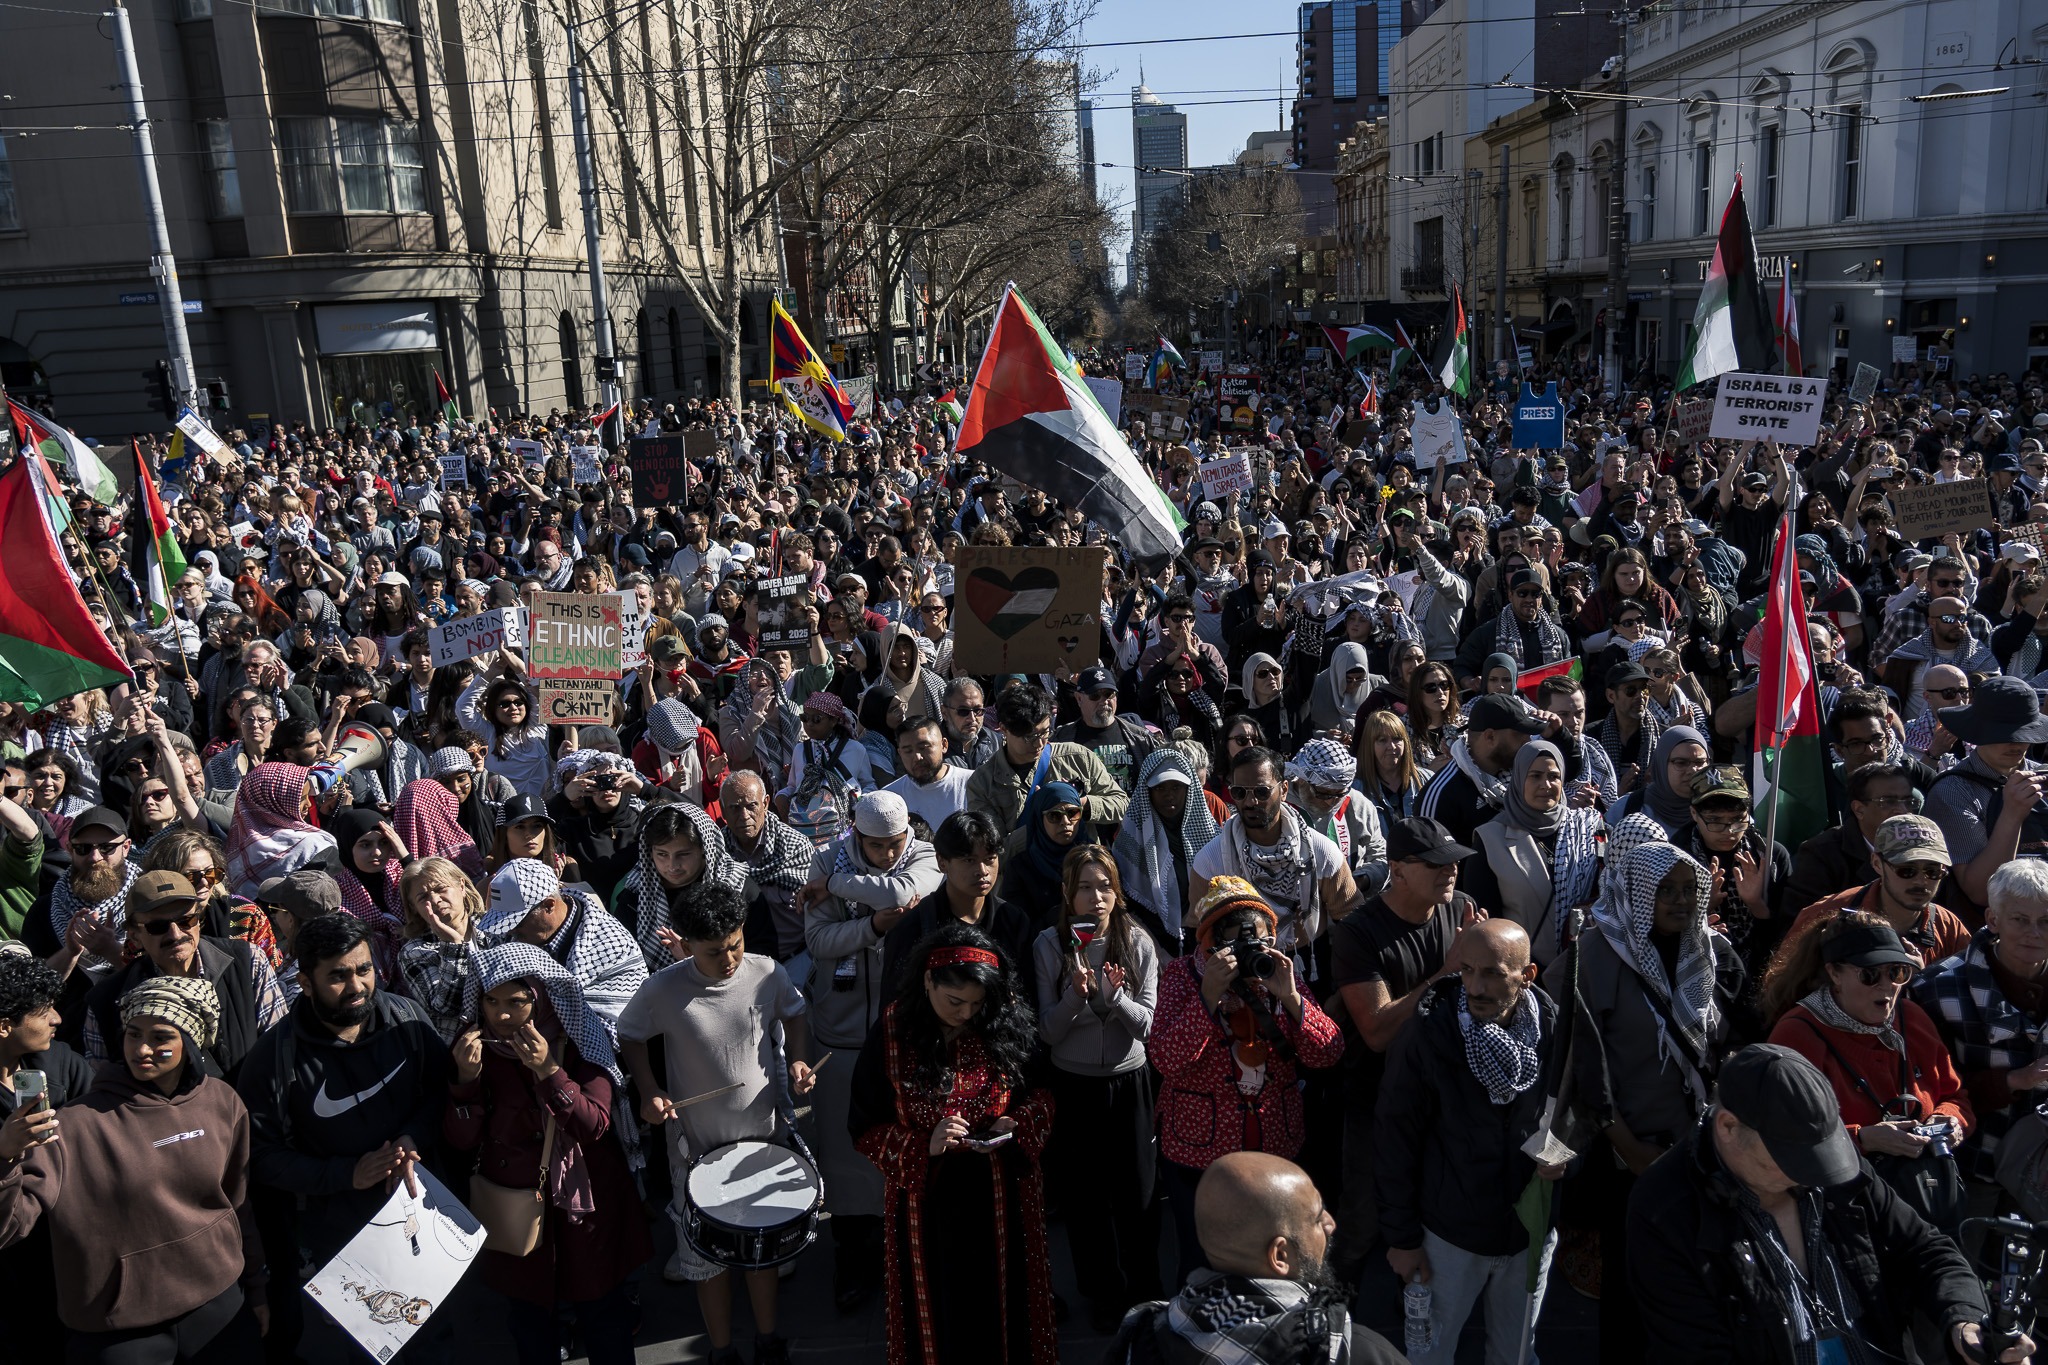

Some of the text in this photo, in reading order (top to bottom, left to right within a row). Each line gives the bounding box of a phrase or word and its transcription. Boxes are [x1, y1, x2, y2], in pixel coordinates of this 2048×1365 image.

[1936, 43, 1963, 56] 1863
[338, 320, 422, 332] HOTEL WINDSOR
[1221, 378, 1248, 388] Rotten
[1725, 379, 1818, 396] ISRAEL IS A
[1220, 386, 1257, 396] Politicians
[1686, 401, 1708, 415] STOP
[1725, 396, 1814, 413] TERRORIST
[1520, 408, 1555, 418] PRESS
[1680, 411, 1713, 428] ARMING
[1738, 415, 1789, 429] STATE
[1685, 423, 1709, 438] ISRAE
[644, 444, 669, 457] STOP
[442, 459, 462, 469] STOP
[633, 457, 681, 472] GENOCIDE
[1201, 459, 1249, 484] DEMILITARISE
[1213, 477, 1240, 495] ISRAEL
[1897, 491, 1909, 503] IF
[1912, 488, 1927, 502] YOU
[1953, 480, 1986, 494] MOURN
[1899, 502, 1916, 513] THE
[1944, 496, 1972, 508] MOURN
[1972, 492, 1987, 503] THE
[1902, 504, 1989, 525] DEATH OF YOUR SOUL
[2010, 522, 2041, 538] FREE
[959, 547, 1096, 569] PALESTINE
[757, 573, 807, 591] NEVER AGAIN
[770, 585, 797, 598] IS NOW
[546, 602, 601, 618] THIS IS
[1044, 609, 1095, 630] GAZA
[466, 629, 505, 654] NOT
[535, 620, 615, 648] ETHNIC
[761, 628, 808, 642] 1945 2025
[531, 645, 621, 670] CLEANSING
[544, 679, 603, 690] NETANYAHU
[564, 692, 593, 700] IS AN
[1099, 744, 1128, 755] JAMES
[307, 1282, 322, 1296] FPP
